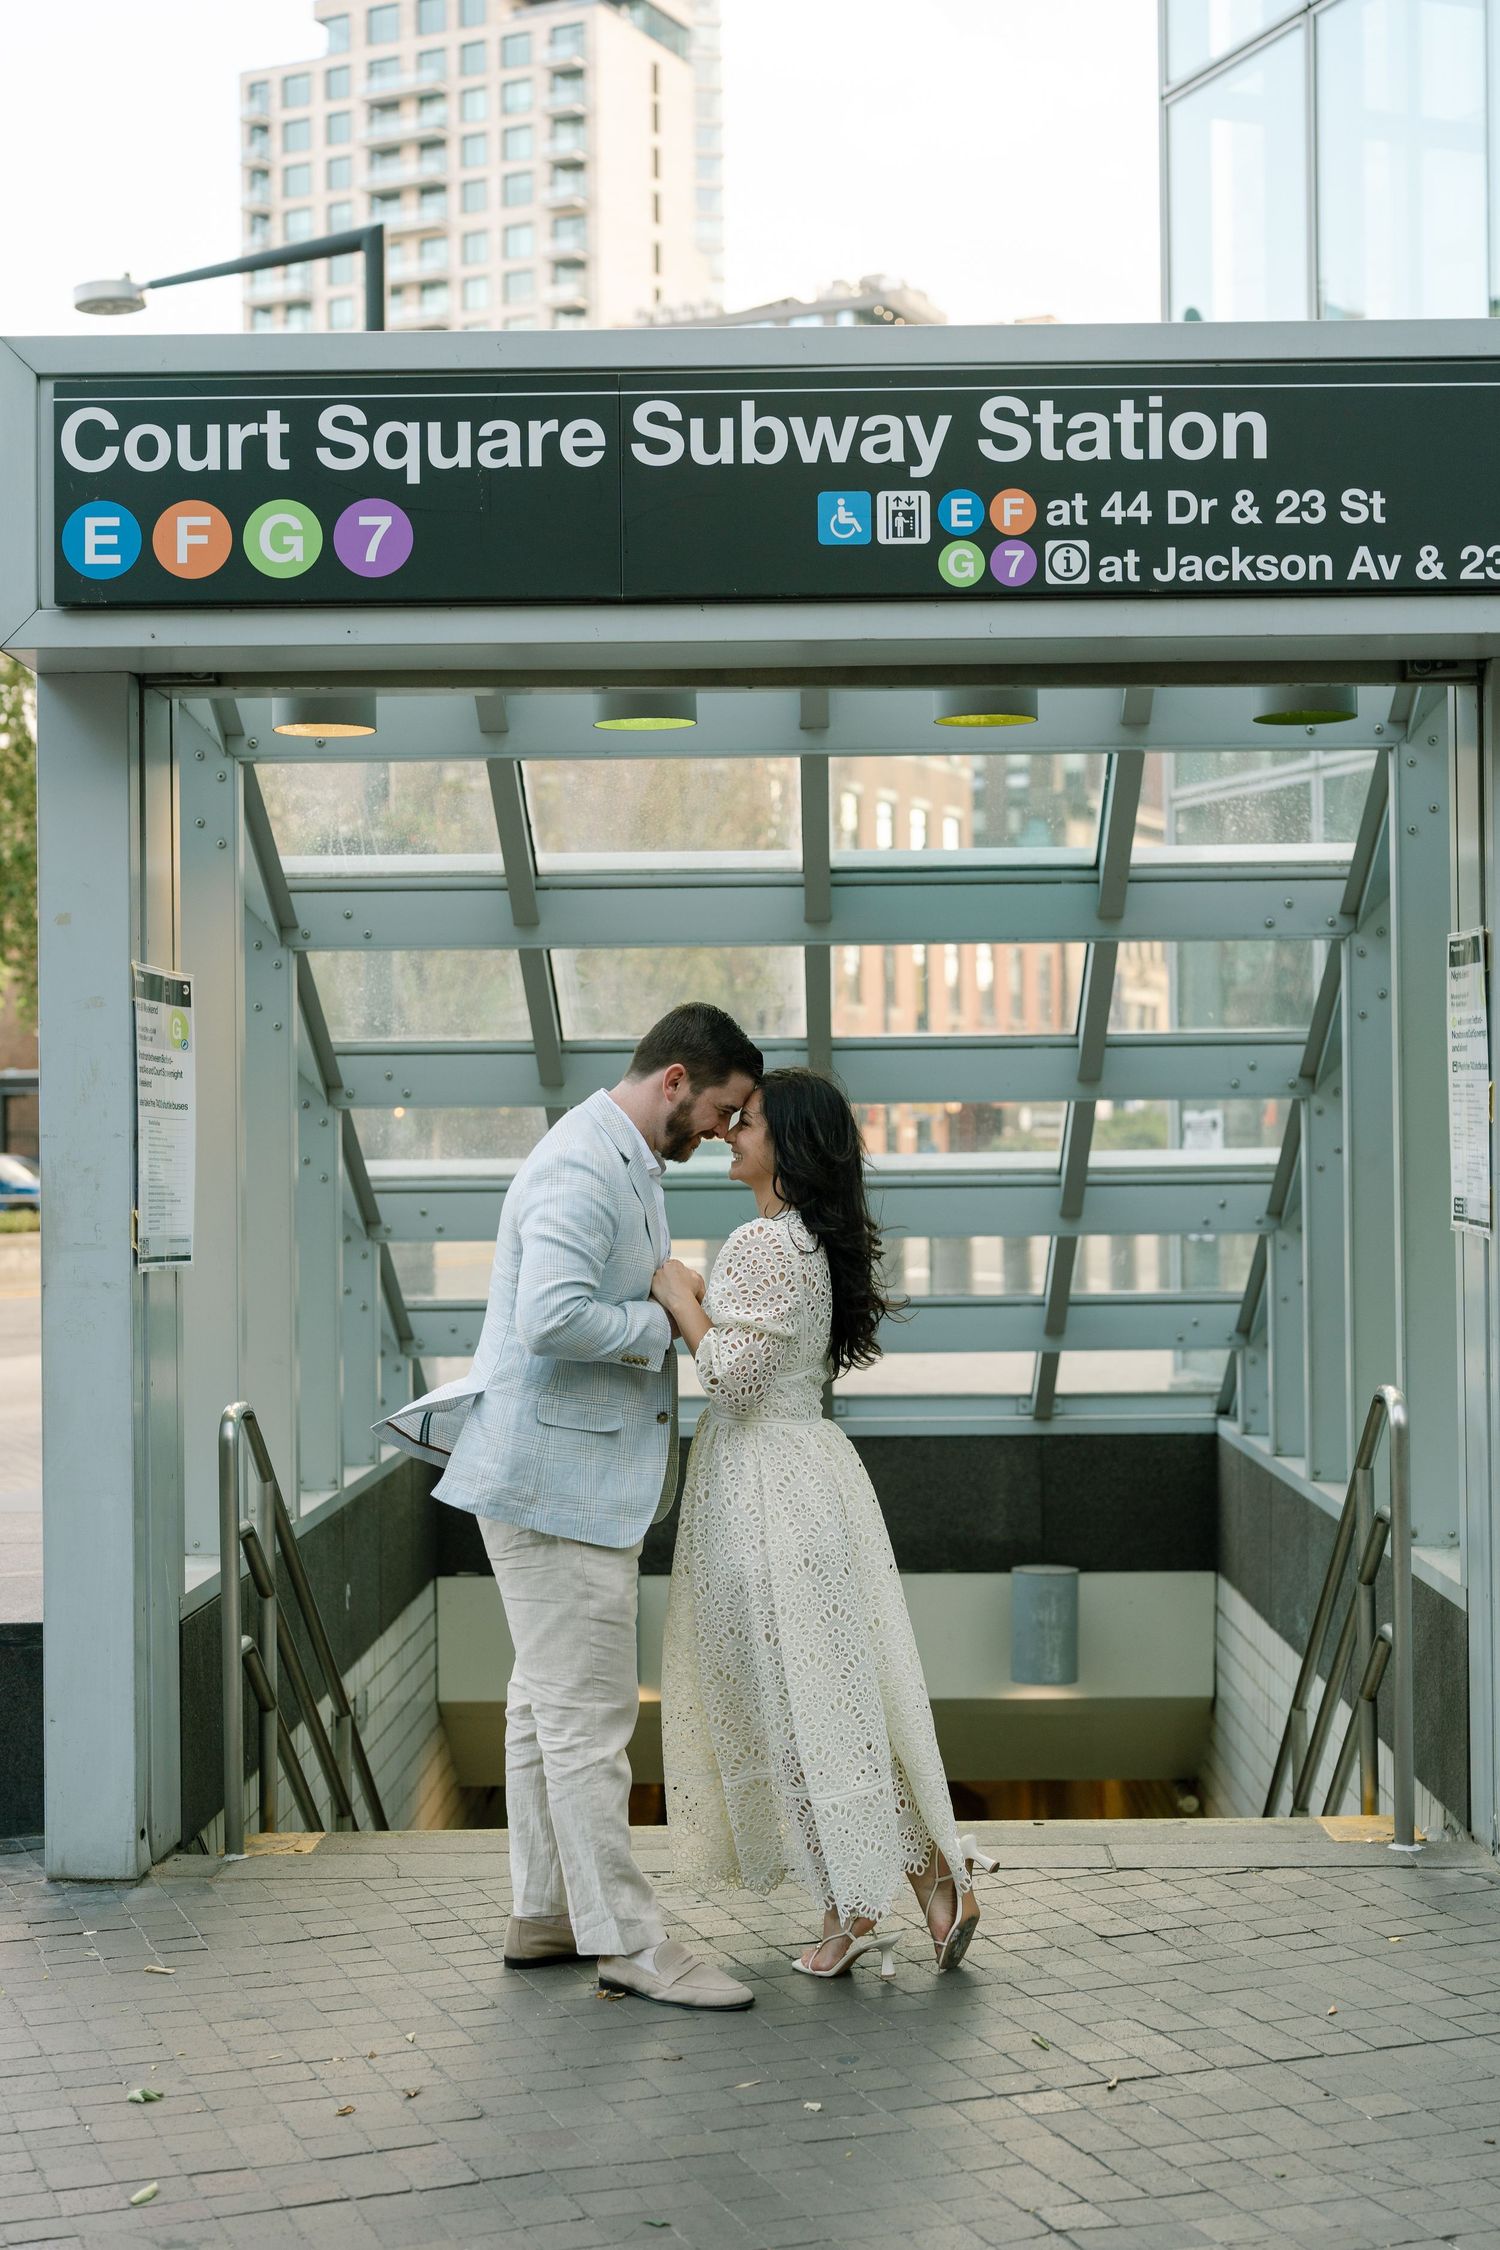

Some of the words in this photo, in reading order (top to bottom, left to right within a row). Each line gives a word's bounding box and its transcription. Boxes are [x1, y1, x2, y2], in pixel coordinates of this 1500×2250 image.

[61, 406, 290, 473] Court
[317, 405, 605, 484] Square
[631, 400, 953, 478] Subway
[978, 395, 1267, 463] Station
[951, 498, 973, 527] E
[1003, 497, 1024, 527] F
[1047, 493, 1088, 526] at
[1101, 491, 1152, 525] 44
[1168, 490, 1217, 525] Dr
[1232, 490, 1262, 525] &
[1276, 489, 1326, 524] 23
[1341, 488, 1386, 525] St
[85, 517, 121, 564] E
[176, 516, 211, 564] F
[259, 513, 304, 563] G
[358, 516, 392, 562] 7
[947, 549, 975, 578] G
[1004, 549, 1024, 578] 7
[1099, 550, 1140, 582] at
[1154, 547, 1333, 582] Jackson
[1347, 546, 1402, 580] Av
[1416, 545, 1447, 580] &
[1460, 545, 1500, 580] 23
[172, 1017, 182, 1039] G
